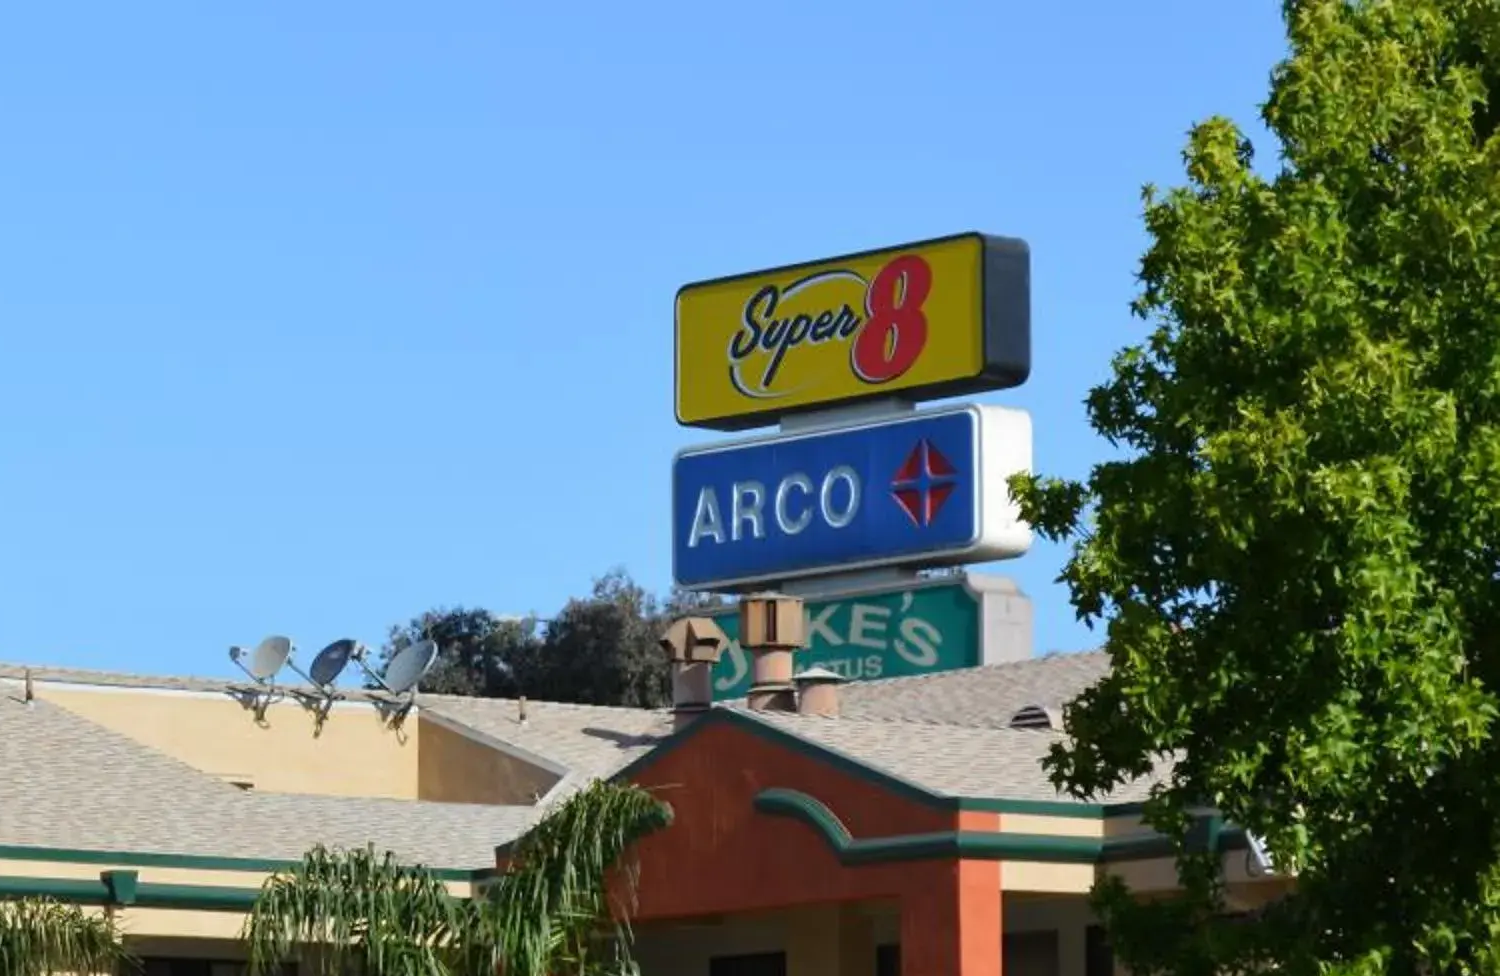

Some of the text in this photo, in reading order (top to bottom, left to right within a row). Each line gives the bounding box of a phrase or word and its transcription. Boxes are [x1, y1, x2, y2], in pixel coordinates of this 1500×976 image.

[728, 254, 932, 390] Super 8
[688, 465, 861, 548] ARCO
[714, 592, 943, 692] JKE'S
